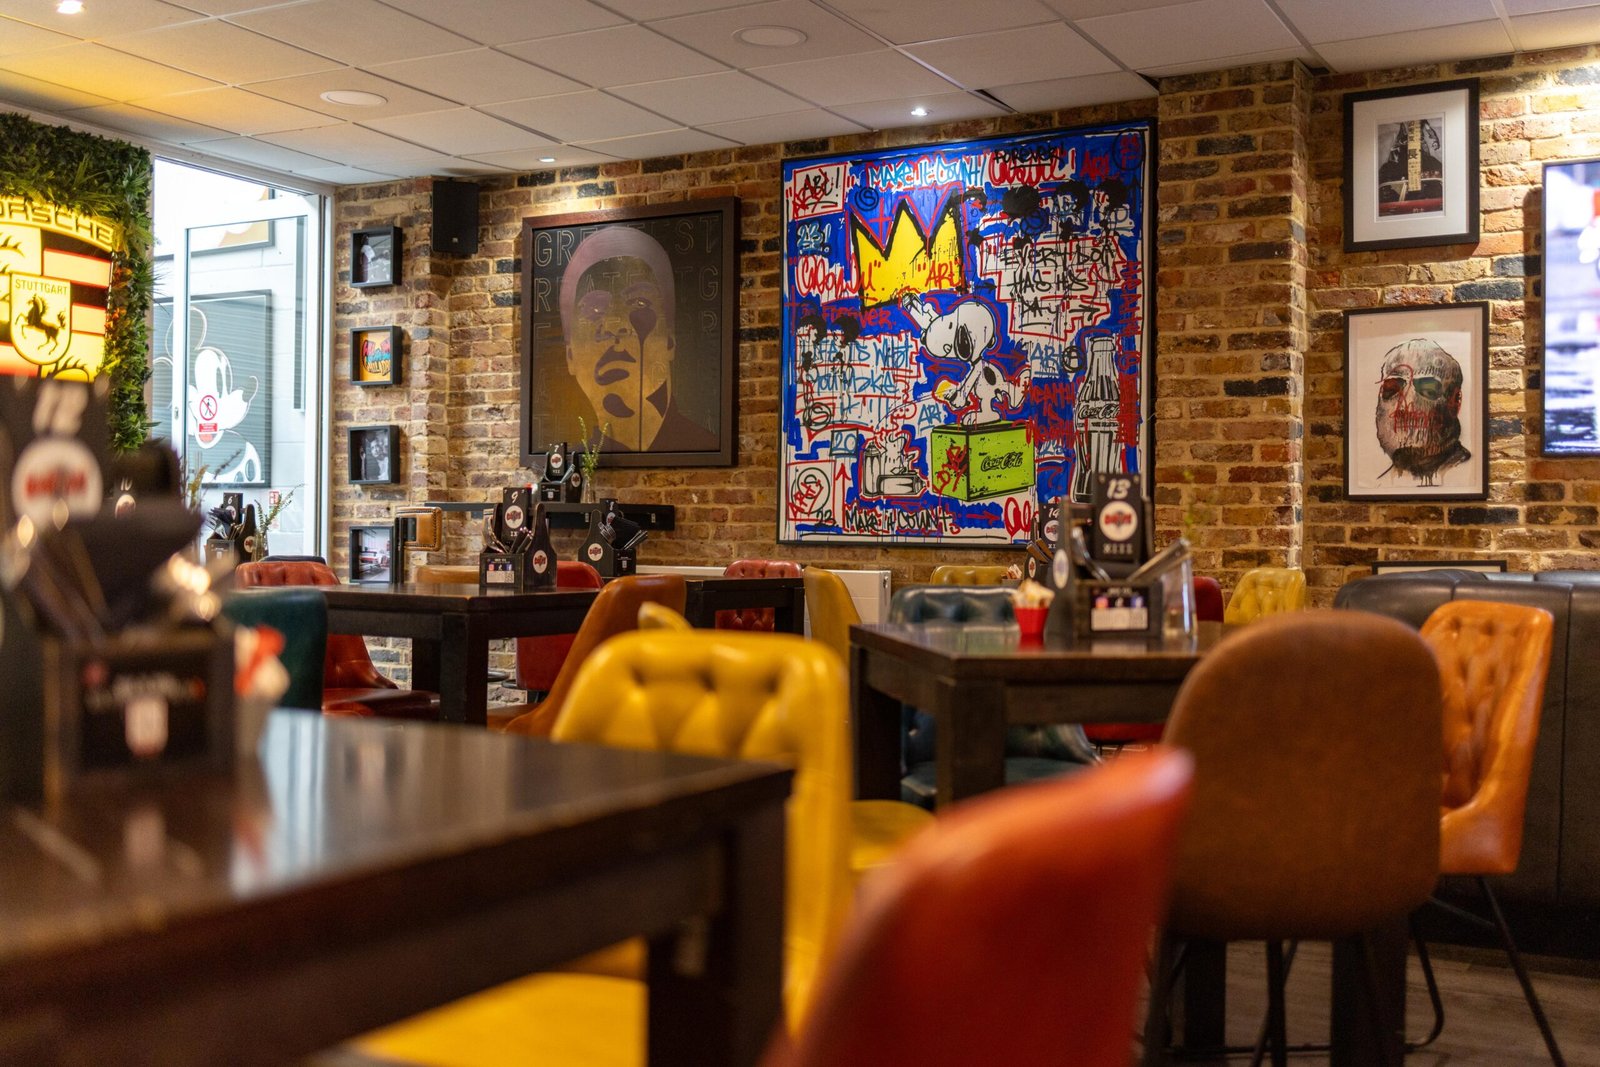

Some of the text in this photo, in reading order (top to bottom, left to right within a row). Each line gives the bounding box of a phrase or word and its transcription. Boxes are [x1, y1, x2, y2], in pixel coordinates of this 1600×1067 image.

[0, 200, 114, 247] RSCHE
[15, 279, 68, 295] STUTTGART
[554, 444, 560, 452] 7
[1107, 478, 1131, 499] 13
[227, 496, 233, 505] 6
[511, 491, 519, 503] 9
[1048, 507, 1060, 519] 14
